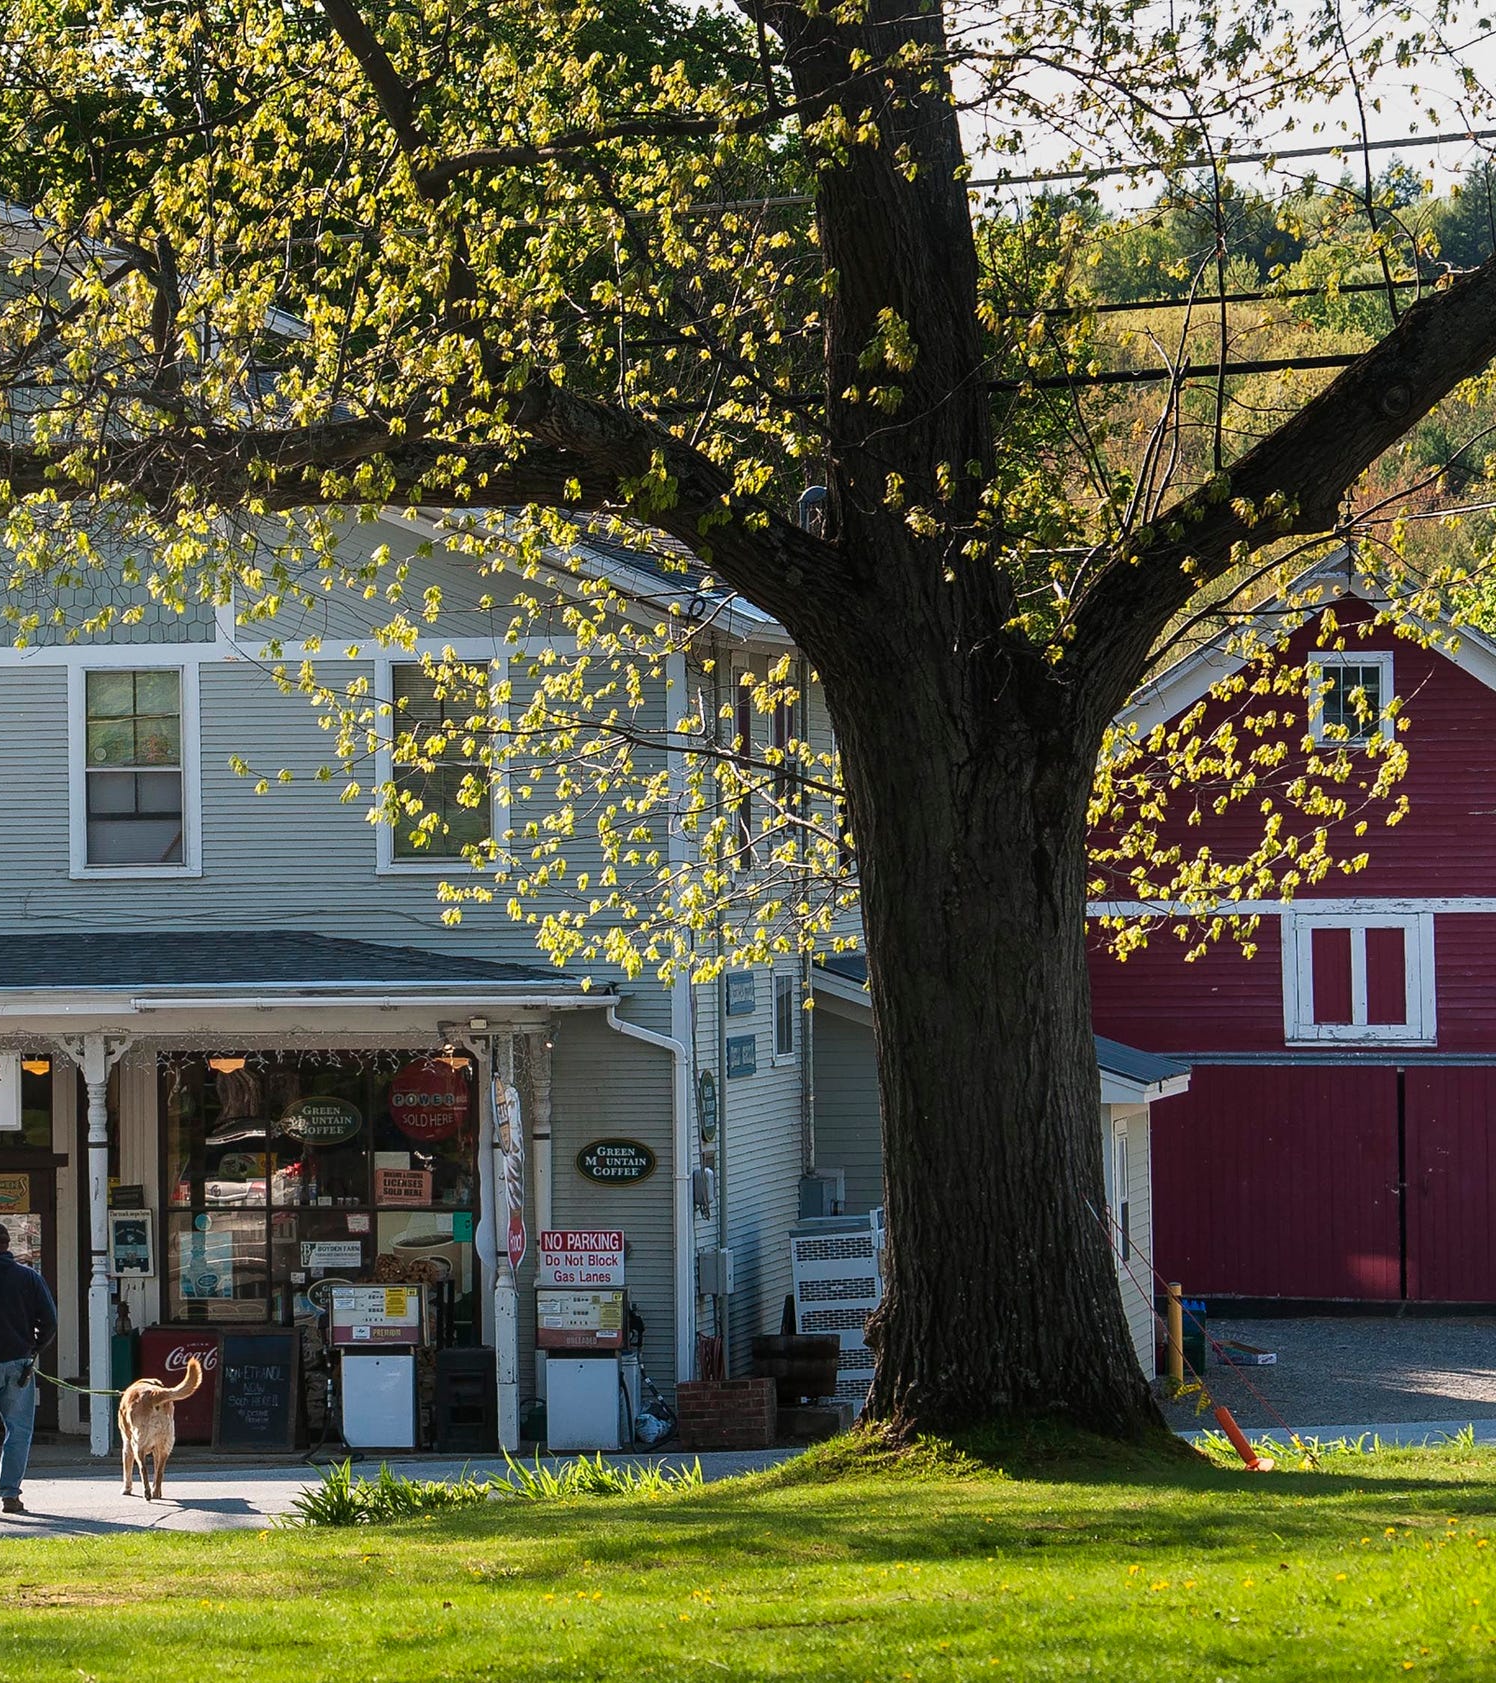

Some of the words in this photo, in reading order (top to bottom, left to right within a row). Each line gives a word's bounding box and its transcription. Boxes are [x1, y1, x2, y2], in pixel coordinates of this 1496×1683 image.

[302, 1106, 341, 1115] GREEN
[402, 1113, 427, 1127] SOLD
[429, 1113, 454, 1127] HERE
[596, 1146, 635, 1156] GREEN
[593, 1166, 639, 1176] COFFEE
[383, 1179, 423, 1188] LICENSES
[383, 1187, 402, 1196] SOLD
[404, 1188, 423, 1197] HERE
[544, 1233, 563, 1250] NO
[567, 1233, 619, 1250] PARKING
[545, 1254, 560, 1266] Do
[565, 1254, 584, 1266] Not
[588, 1254, 618, 1266] Block
[554, 1270, 575, 1282] Gas
[579, 1270, 611, 1282] Lanes
[372, 1328, 401, 1337] PREMIUM
[165, 1346, 218, 1372] Coca-C
